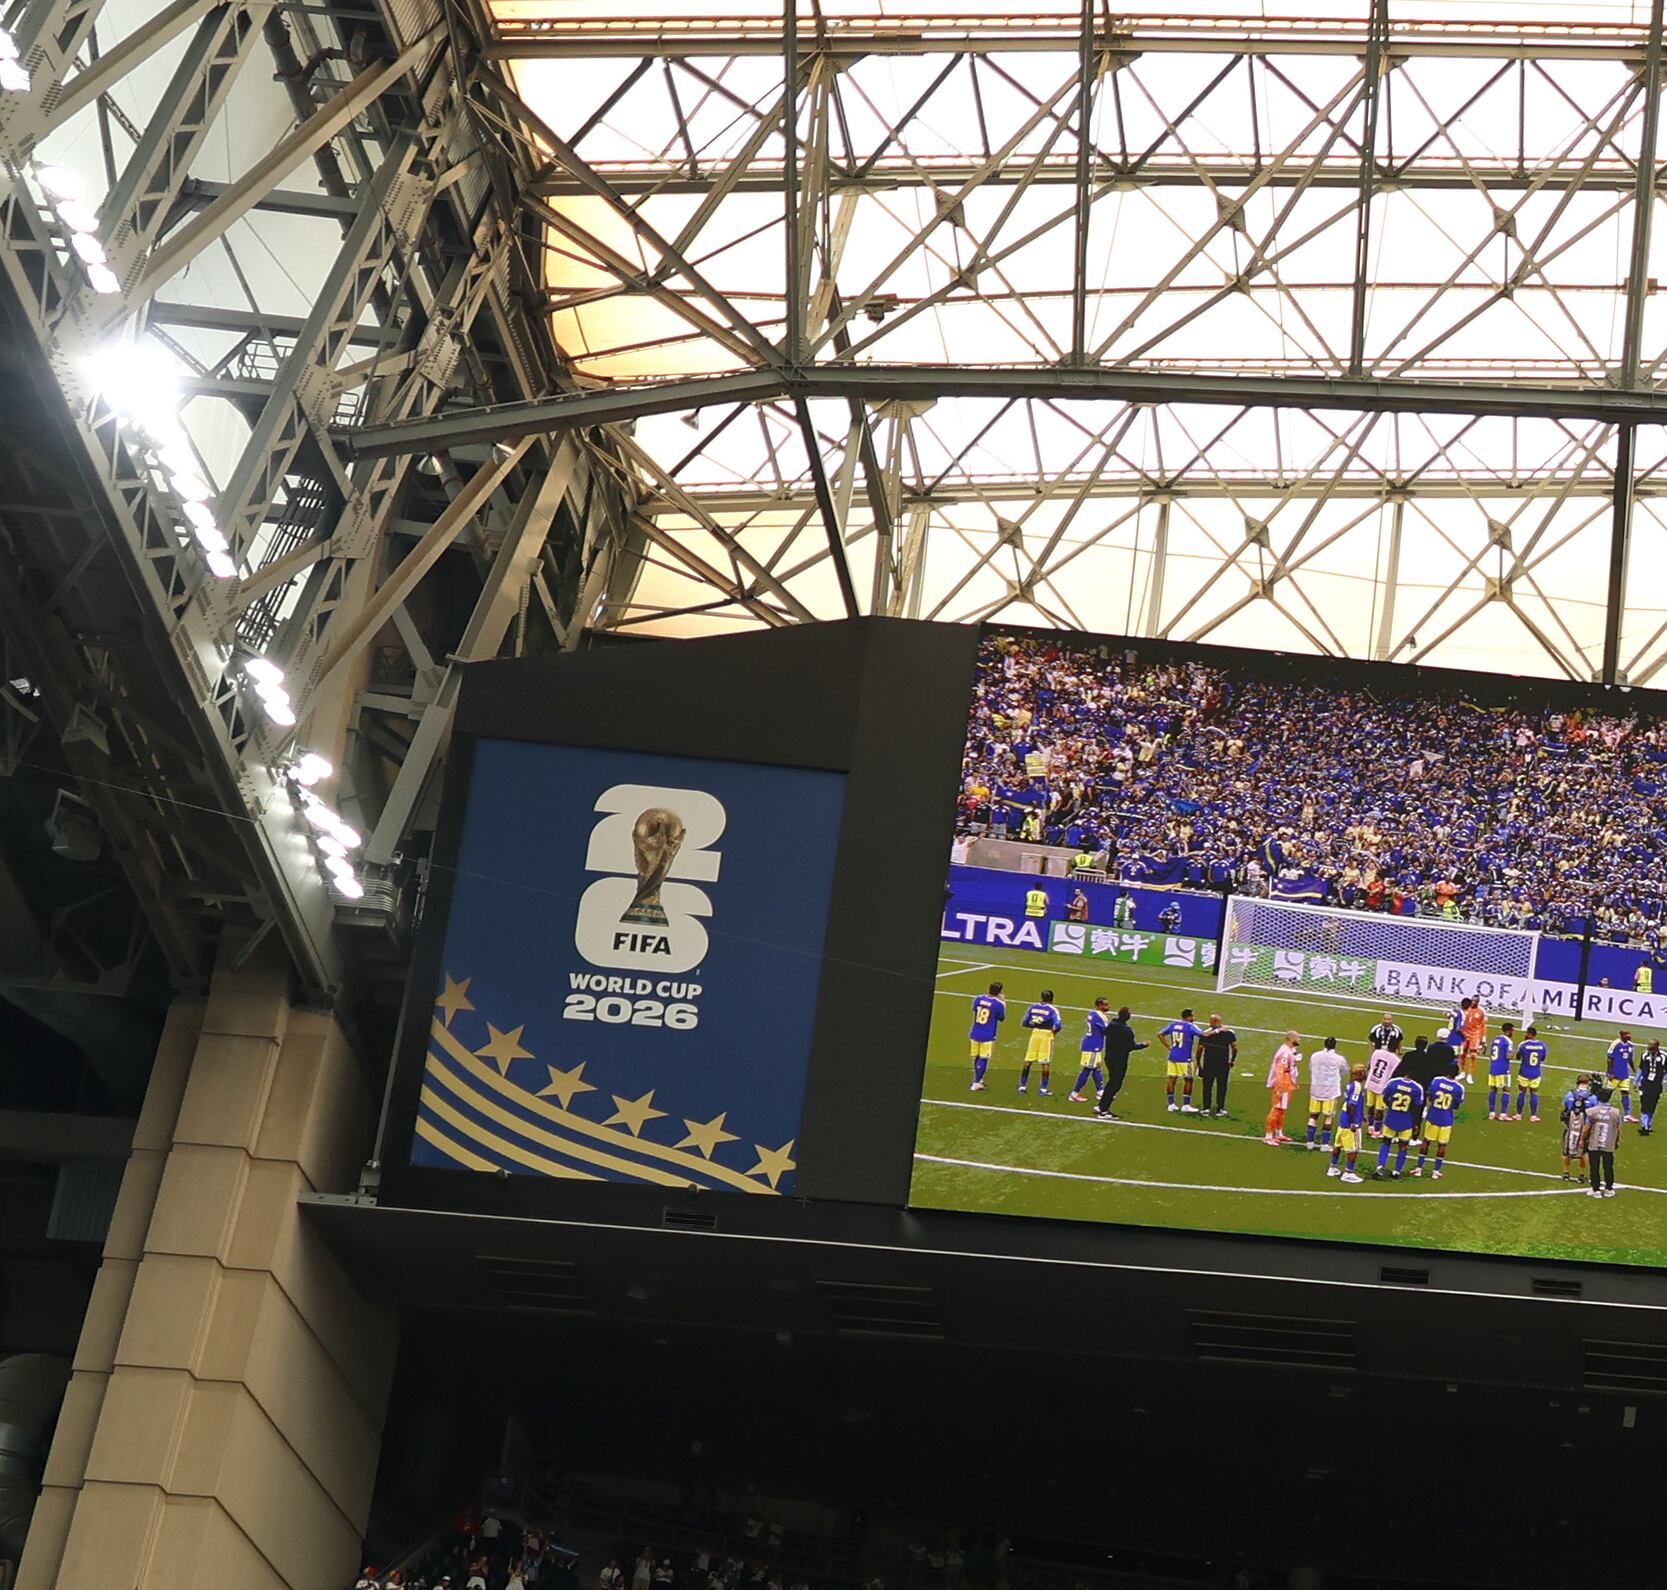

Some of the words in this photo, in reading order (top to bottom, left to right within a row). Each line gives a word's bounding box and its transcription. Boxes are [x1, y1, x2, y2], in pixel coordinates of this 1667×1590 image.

[612, 932, 672, 956] FIFA
[1091, 929, 1150, 961] 蒙牛
[1386, 968, 1466, 994] BANK
[1477, 980, 1511, 1000] OF
[568, 972, 653, 996] WORLD
[658, 980, 703, 1000] CUP
[562, 994, 699, 1031] 2026
[1434, 1093, 1453, 1110] 20
